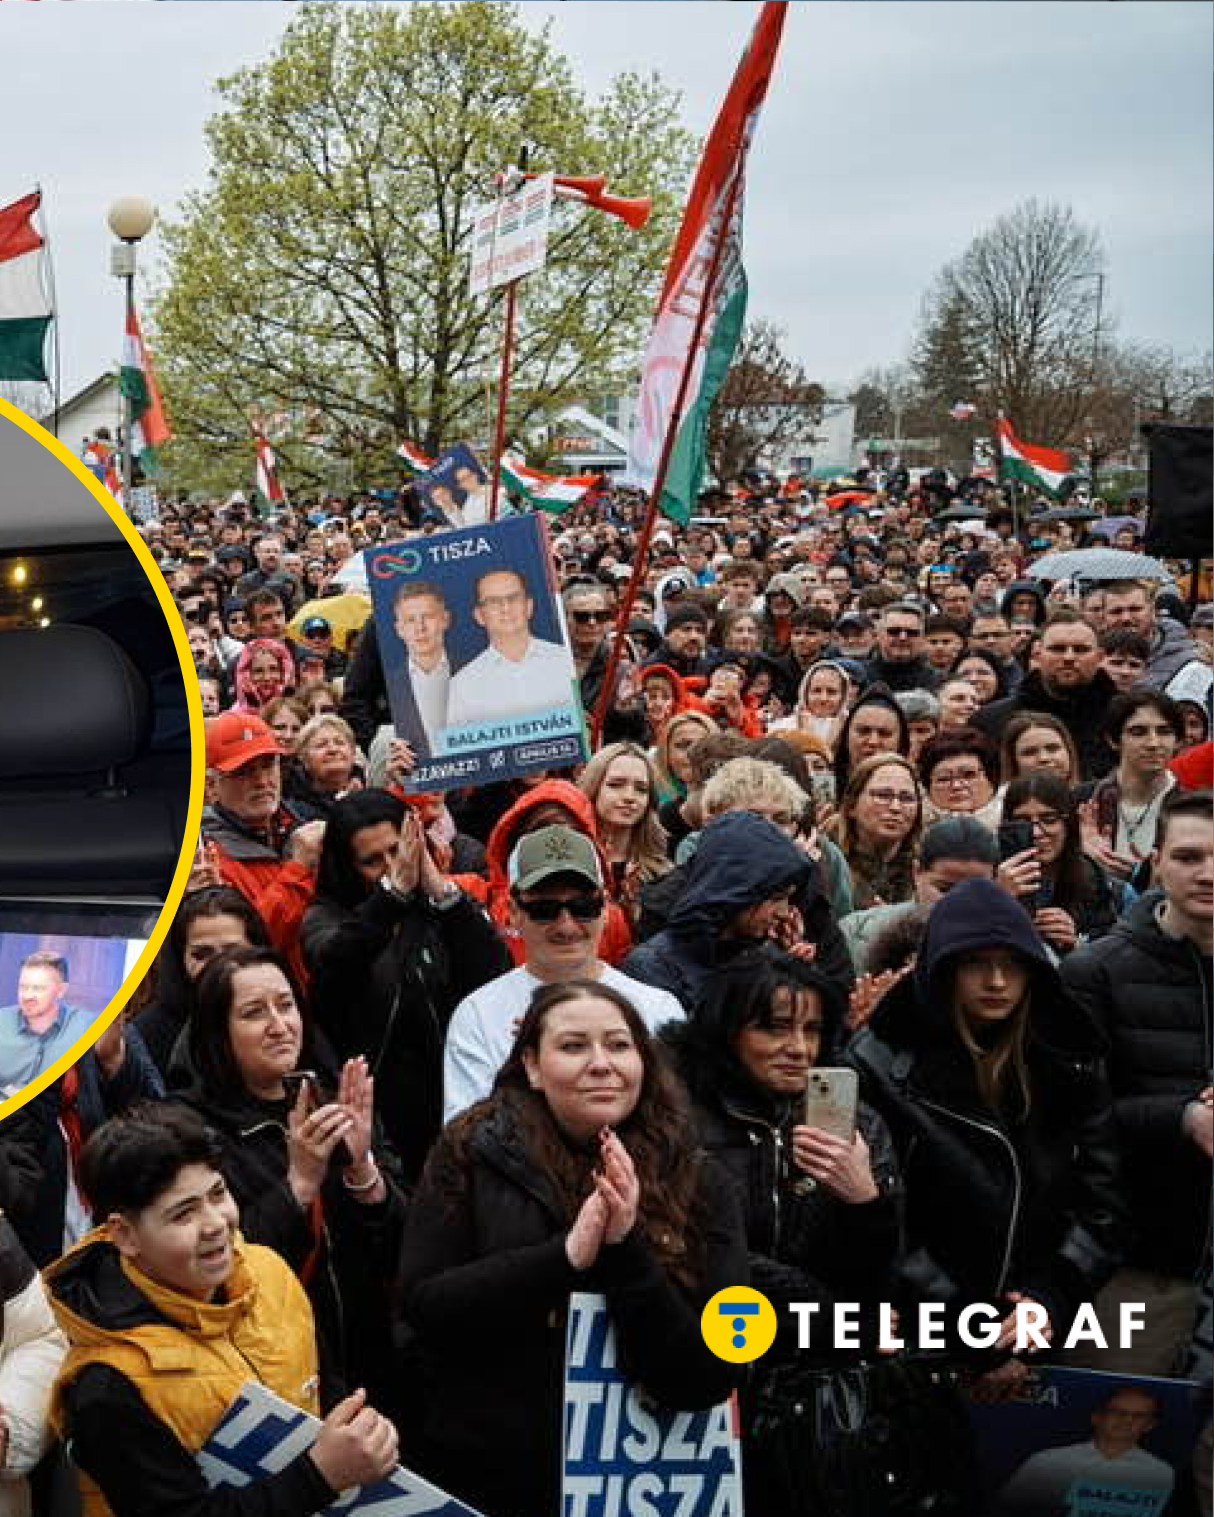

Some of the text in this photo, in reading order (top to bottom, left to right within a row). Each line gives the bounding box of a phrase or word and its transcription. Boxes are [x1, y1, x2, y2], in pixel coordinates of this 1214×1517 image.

[427, 537, 491, 563] TISZA
[447, 713, 573, 749] BALAJTI ISTVÁN
